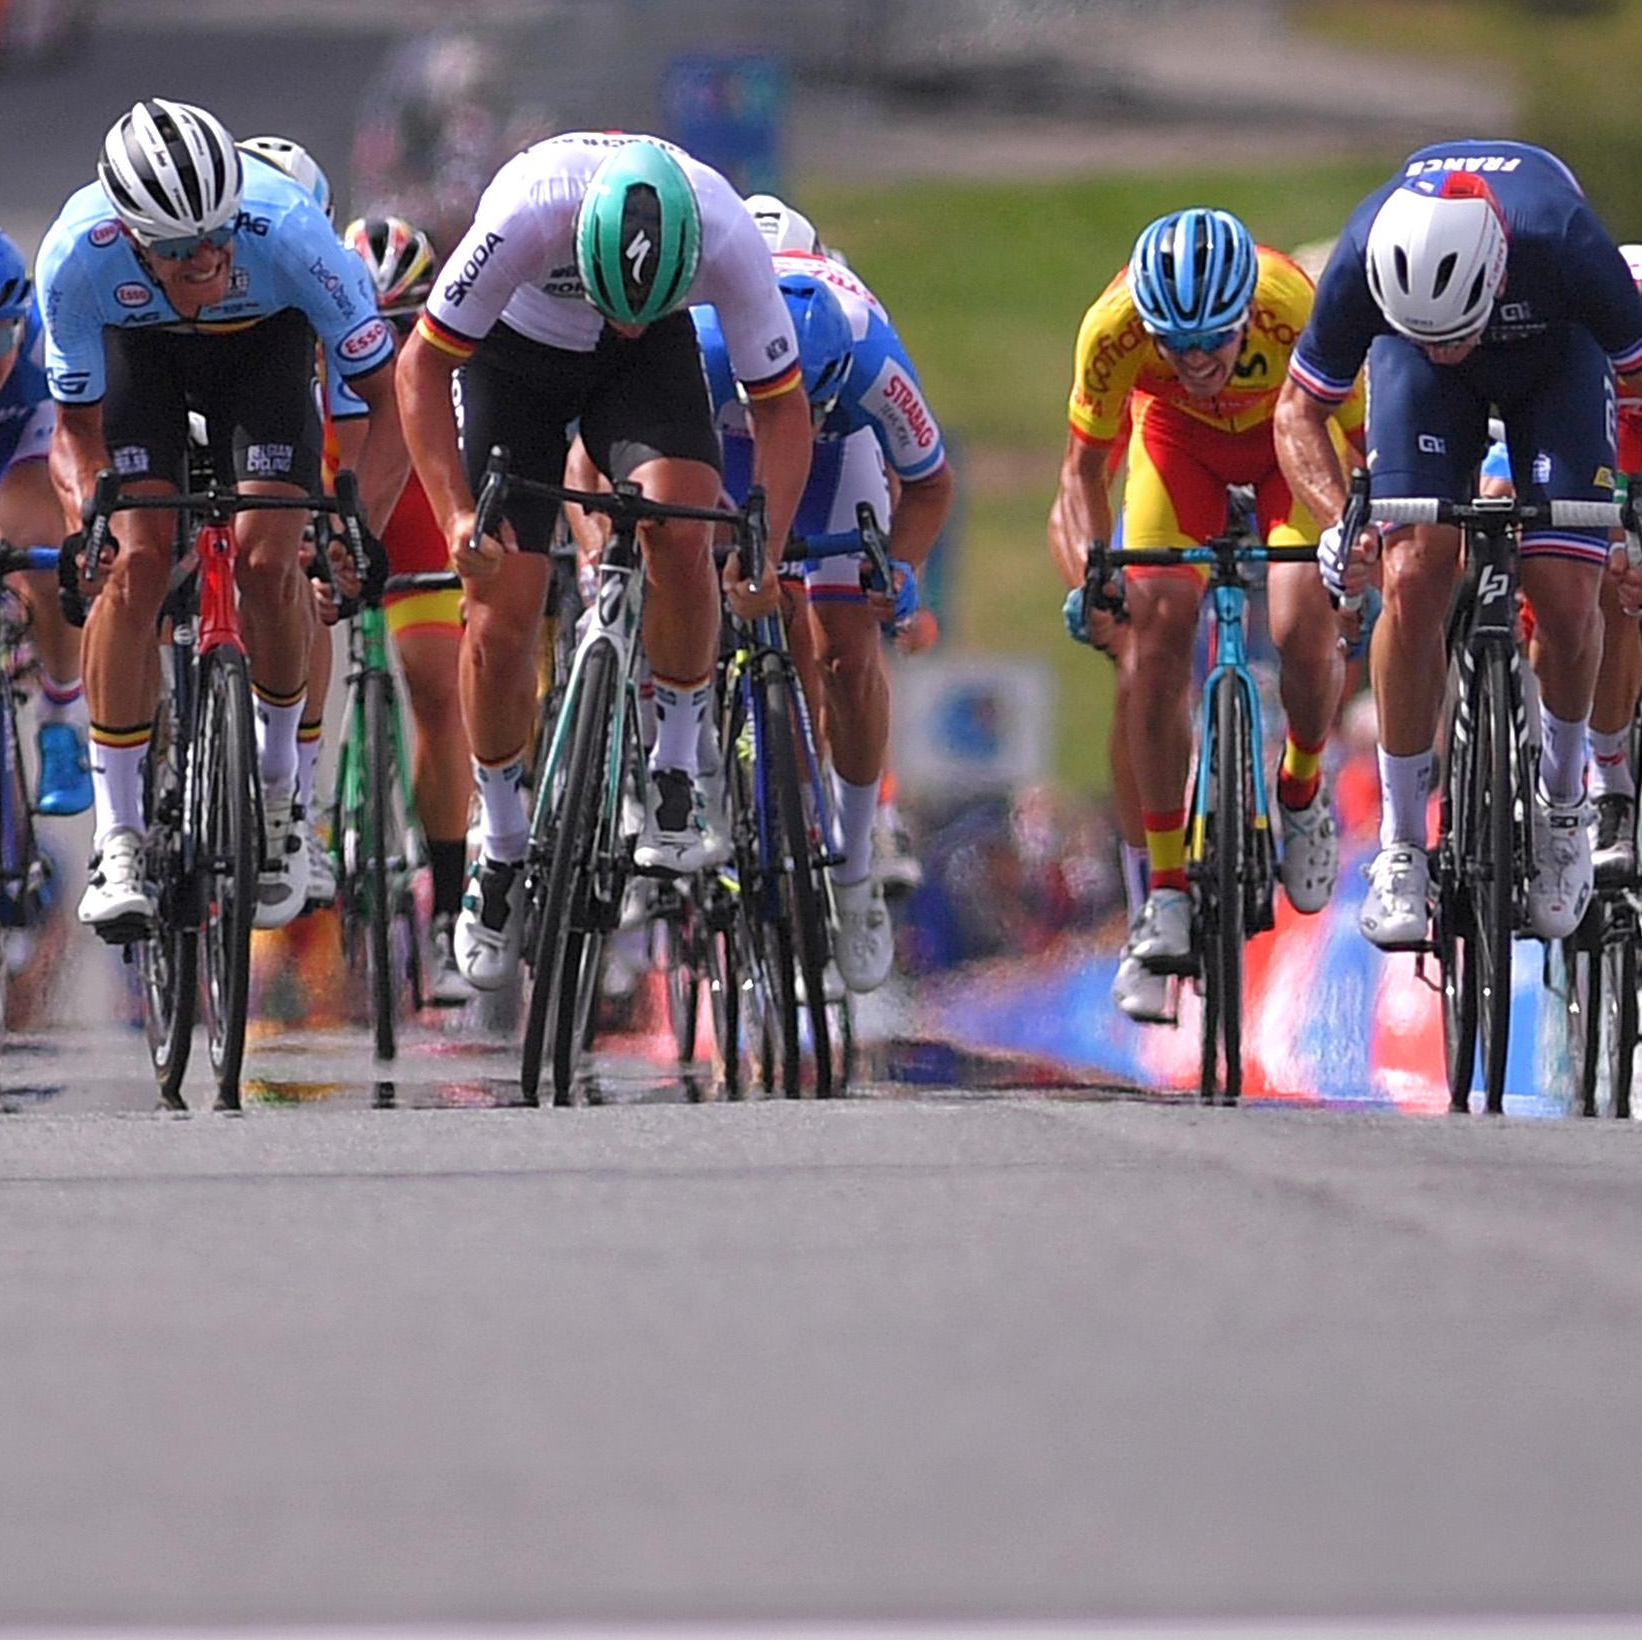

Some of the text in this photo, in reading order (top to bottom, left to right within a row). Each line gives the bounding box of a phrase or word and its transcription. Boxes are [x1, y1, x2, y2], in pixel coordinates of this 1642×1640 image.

[1405, 156, 1522, 177] FRANCE
[444, 231, 505, 307] ŠKODA
[119, 288, 147, 301] Esso
[344, 323, 385, 355] Esso
[883, 374, 935, 448] STRABAG
[247, 443, 294, 460] BELGIAN
[246, 458, 292, 473] CYCLING
